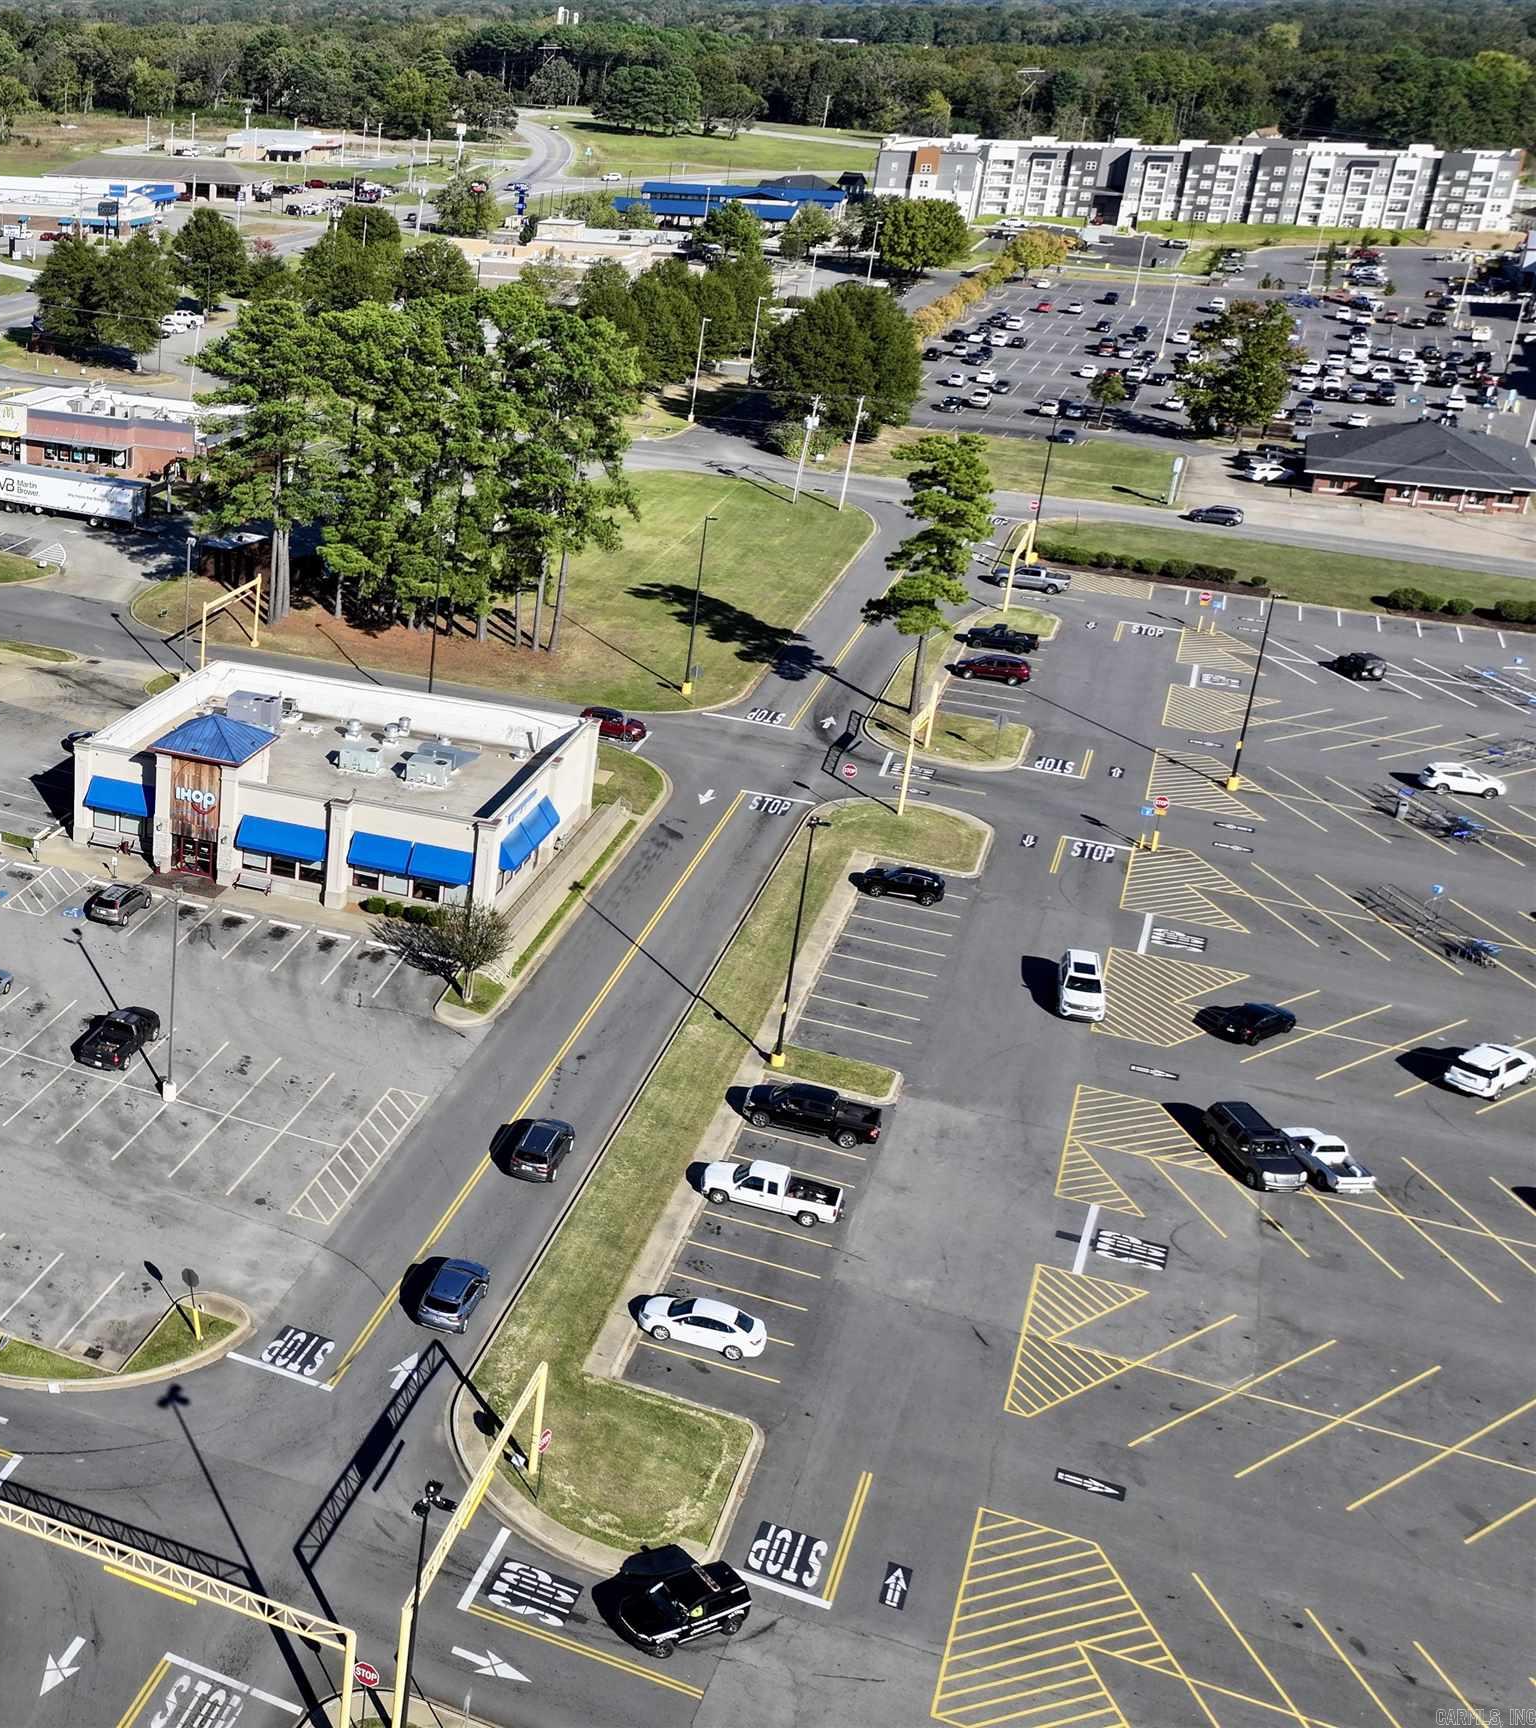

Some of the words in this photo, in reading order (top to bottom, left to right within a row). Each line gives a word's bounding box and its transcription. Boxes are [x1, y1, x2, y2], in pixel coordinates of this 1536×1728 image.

[16, 480, 38, 490] Martin
[1131, 624, 1164, 637] STOP
[747, 708, 786, 725] STOP
[1035, 757, 1075, 774] STOP
[749, 796, 792, 815] STOP
[1070, 842, 1115, 863] STOP
[261, 1328, 336, 1377] STOP
[747, 1524, 829, 1588] STOP
[487, 1561, 580, 1627] STOP
[355, 1666, 378, 1682] STOP
